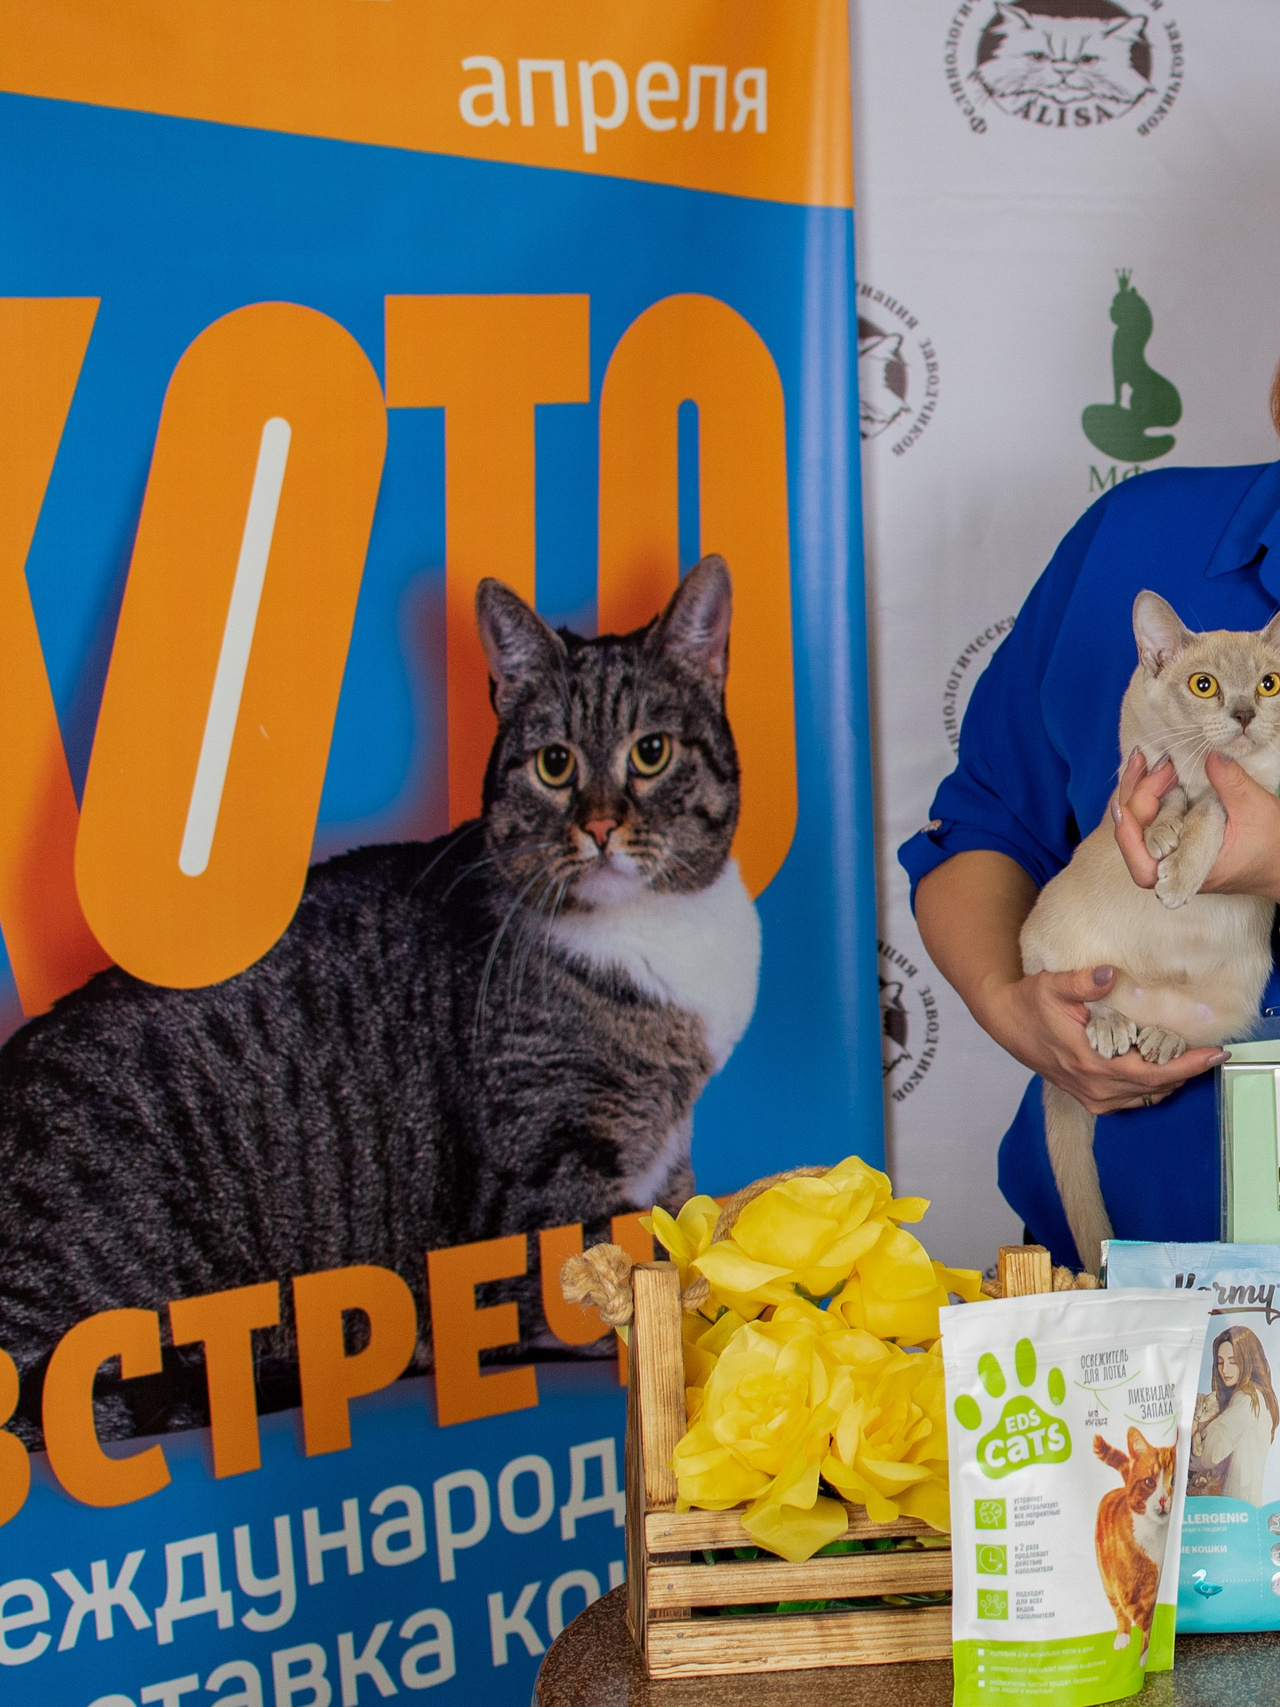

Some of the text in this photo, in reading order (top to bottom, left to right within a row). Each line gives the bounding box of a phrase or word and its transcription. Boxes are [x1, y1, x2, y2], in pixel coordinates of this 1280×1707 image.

[458, 55, 769, 154] апреля
[1013, 99, 1114, 128] ALISA
[0, 1205, 662, 1528] СТРЕЧ
[1080, 1348, 1129, 1369] ОСВЕЖИТЕЛЬ
[1083, 1364, 1127, 1385] ДЛЯ ЛОТКА
[1004, 1408, 1041, 1434] EDS
[1140, 1400, 1174, 1420] ЗАПАХА
[1191, 1544, 1228, 1554] КОШКИ
